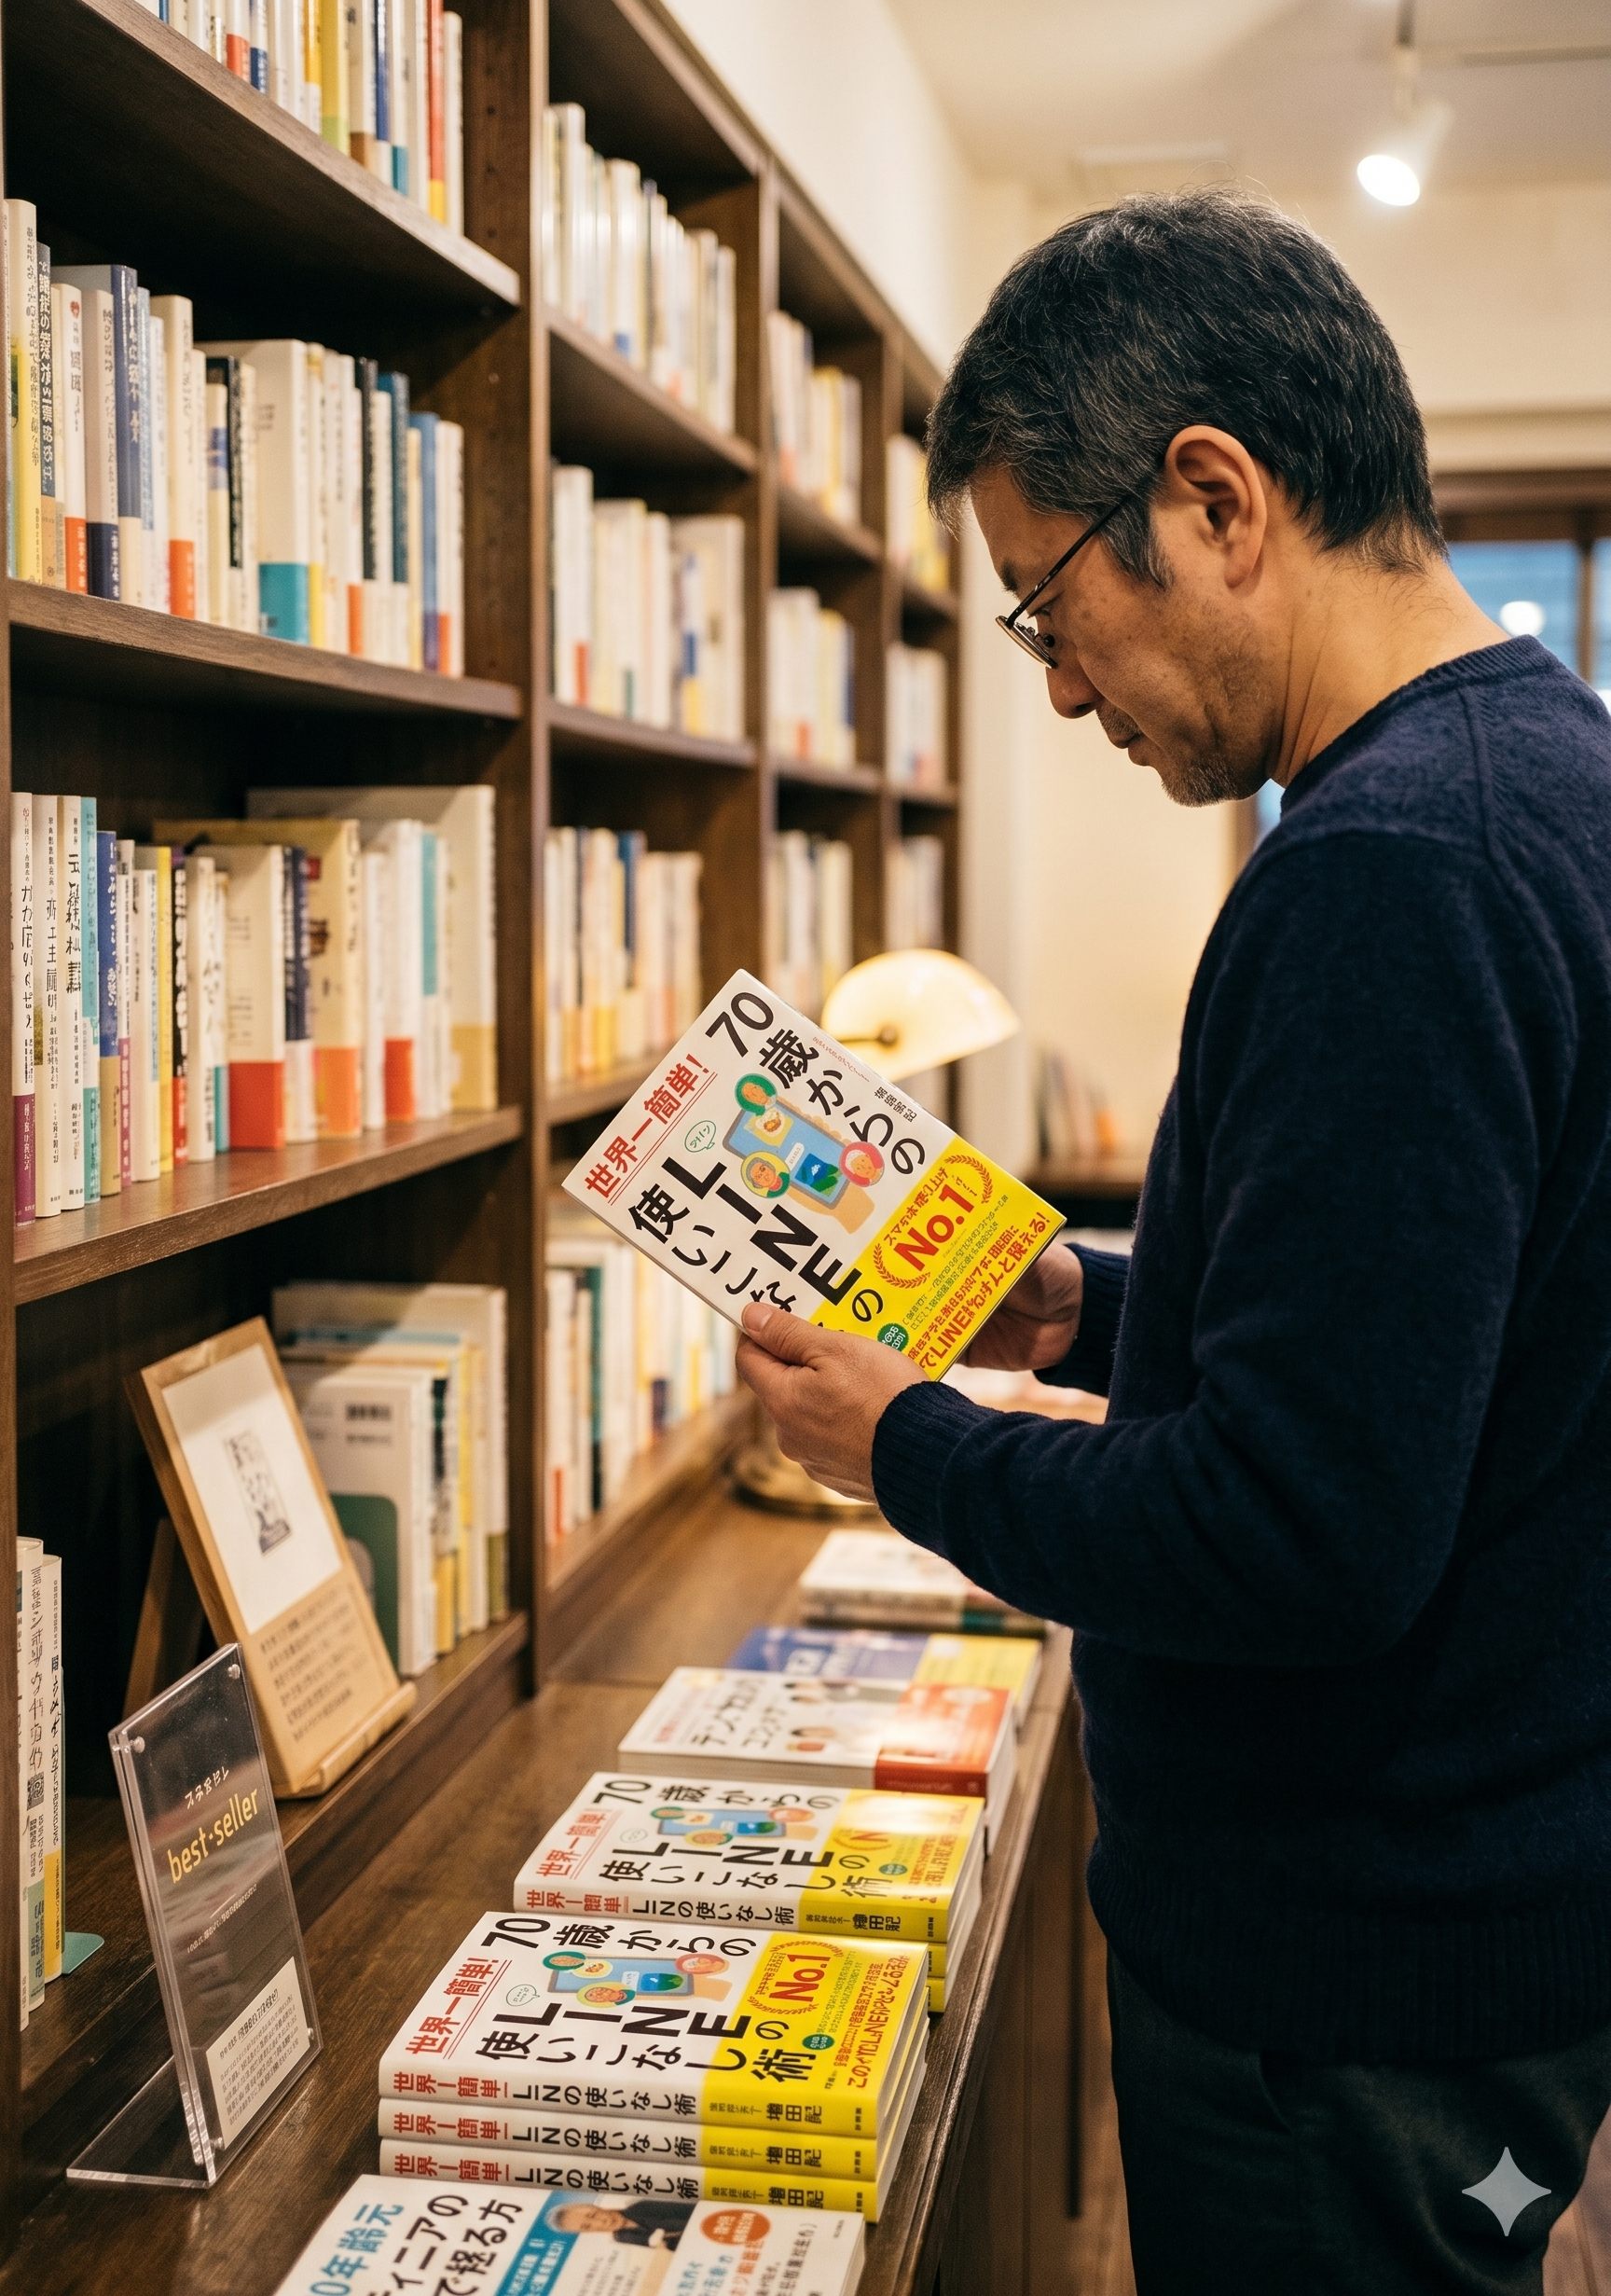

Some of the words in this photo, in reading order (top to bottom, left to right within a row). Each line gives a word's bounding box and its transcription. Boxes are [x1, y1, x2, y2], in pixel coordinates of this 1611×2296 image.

[893, 1183, 974, 1271] No.1
[612, 1842, 870, 1870] LINEの
[481, 1917, 756, 1957] 70歳からの
[769, 1954, 831, 2002] No.1
[494, 2002, 790, 2040] LINEの
[475, 2029, 817, 2082] 使いこなし術
